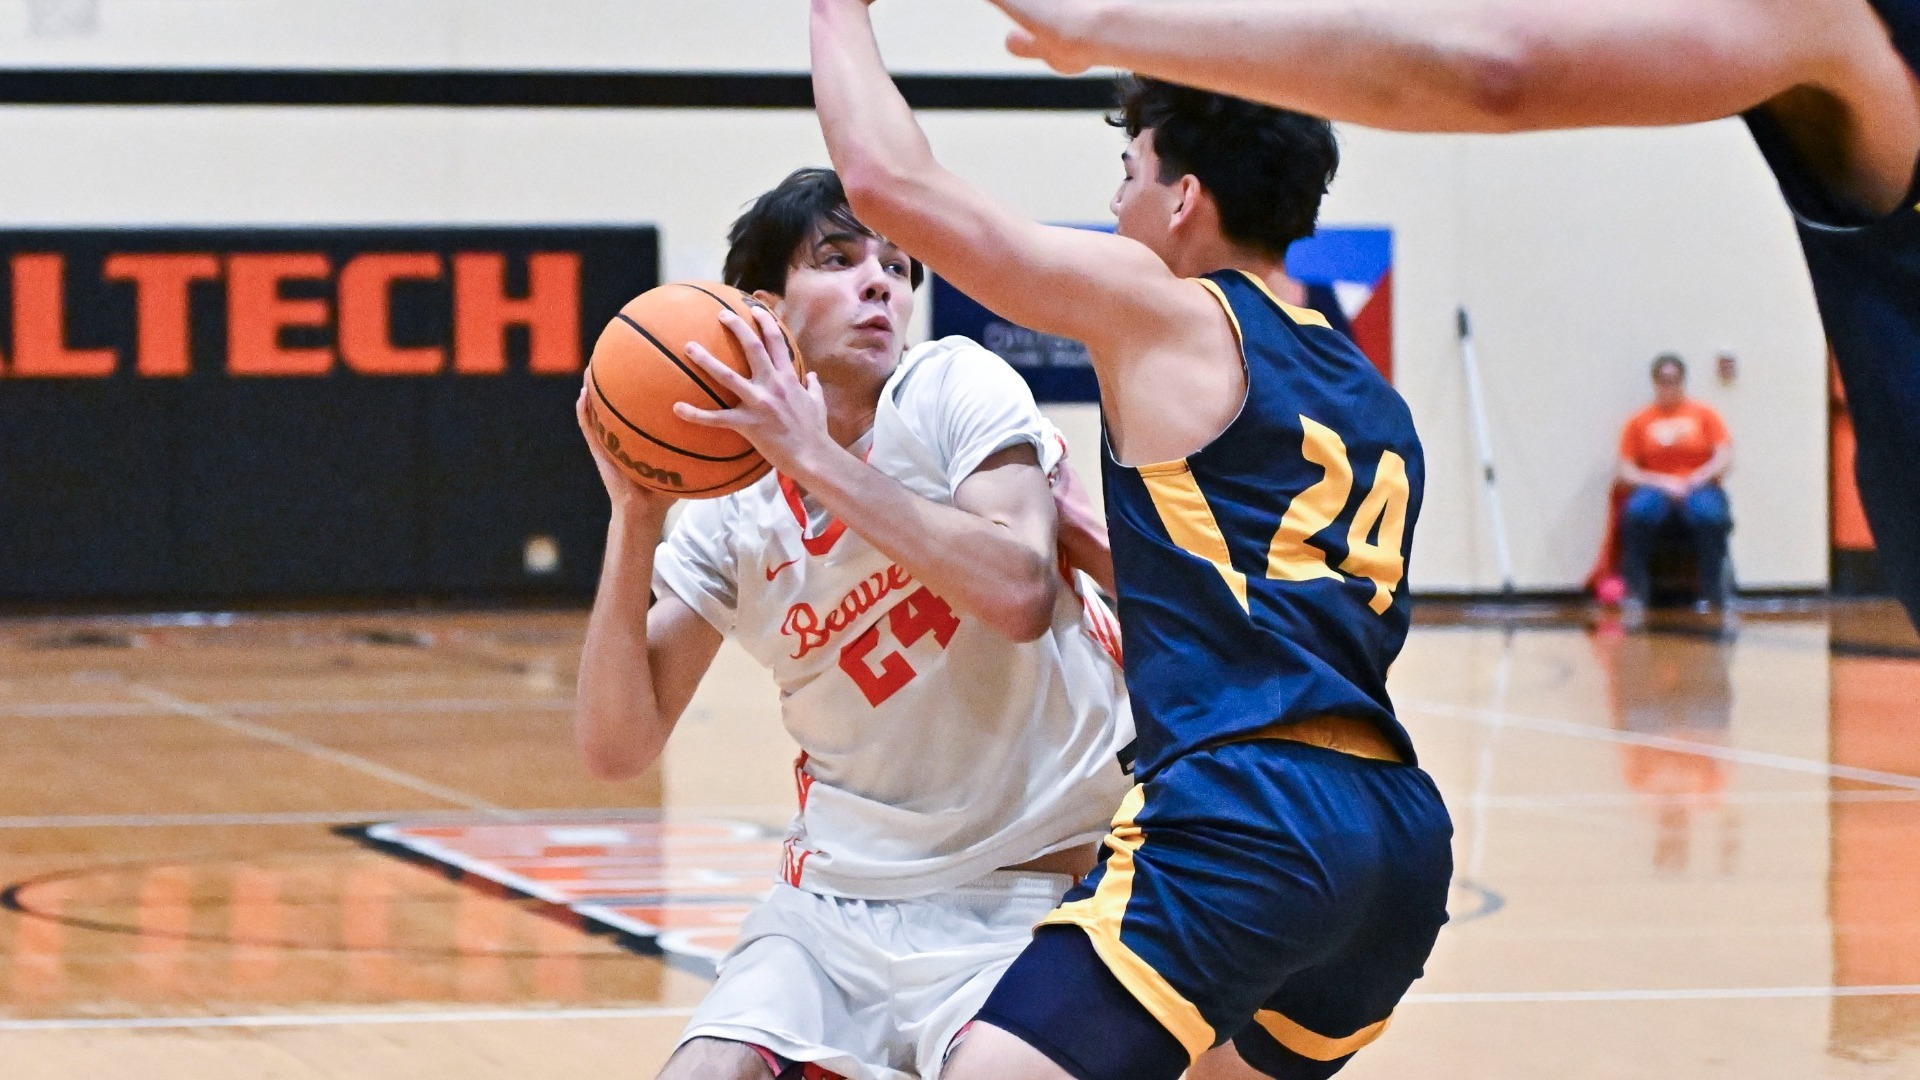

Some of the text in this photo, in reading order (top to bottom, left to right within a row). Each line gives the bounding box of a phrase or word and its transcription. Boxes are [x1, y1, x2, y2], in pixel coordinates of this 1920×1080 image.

[0, 252, 582, 377] LTECH
[1265, 413, 1410, 616] 24
[781, 563, 912, 660] Beave
[838, 585, 961, 709] 24
